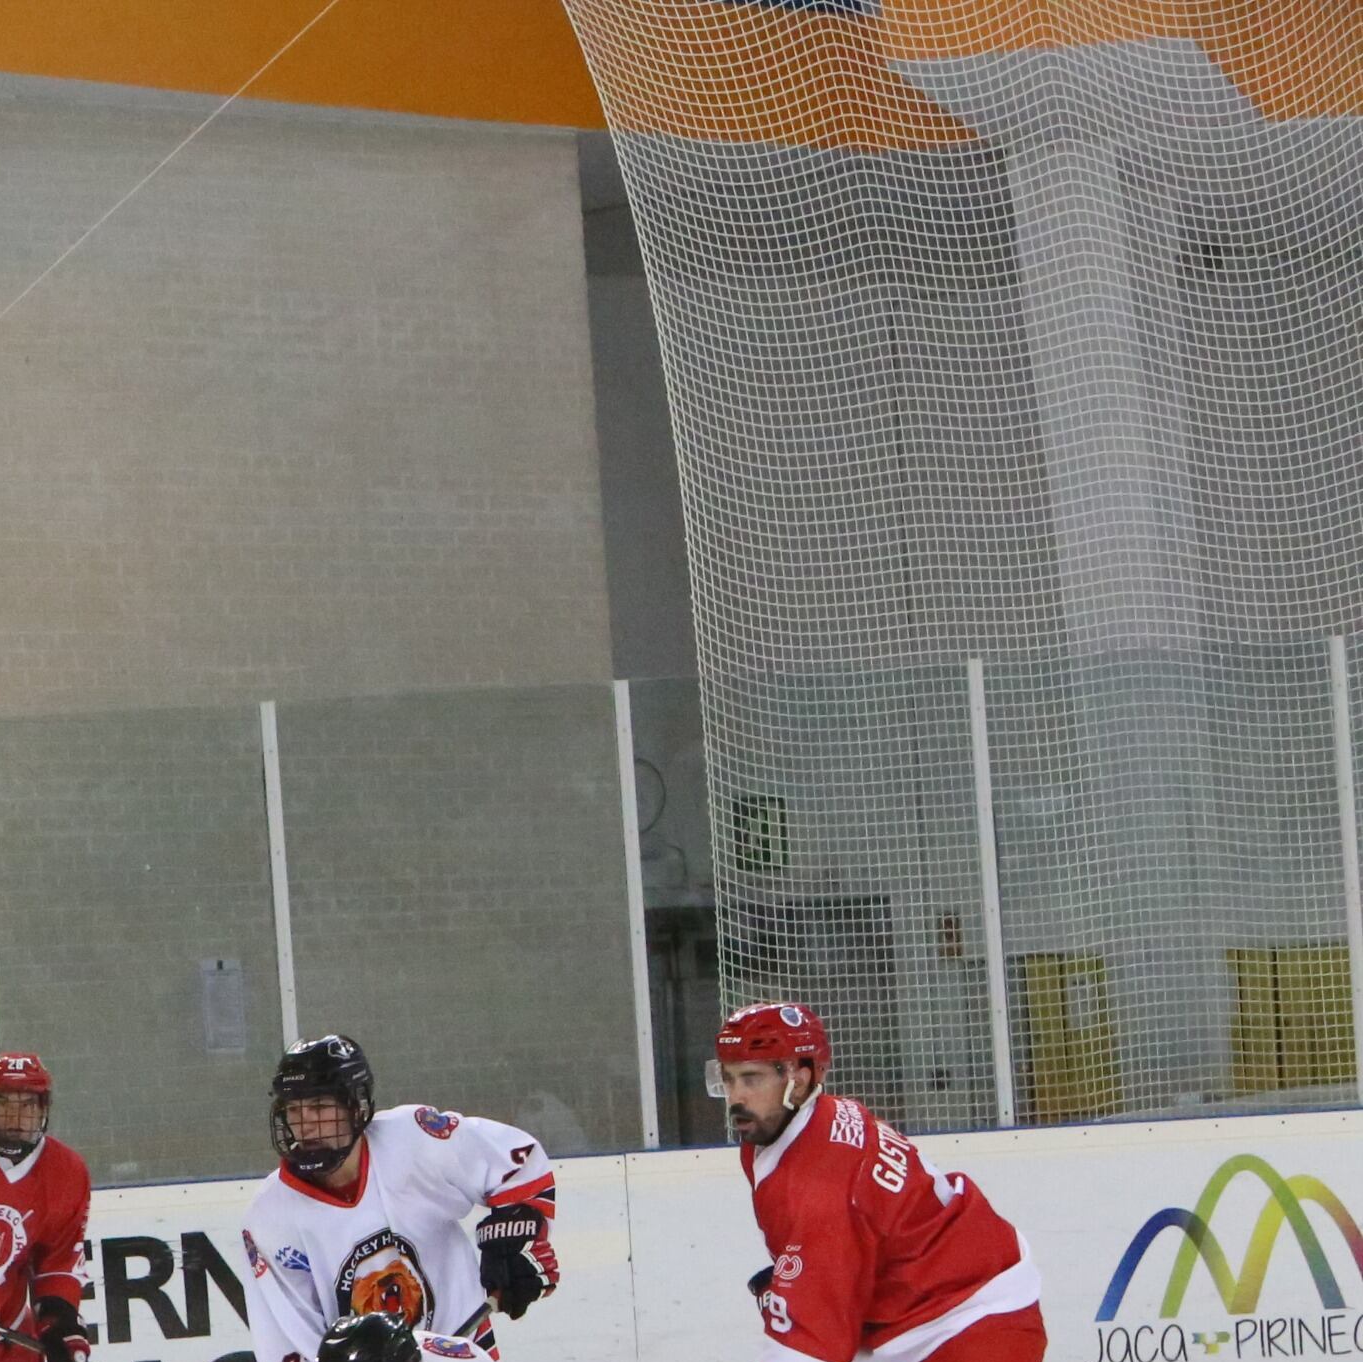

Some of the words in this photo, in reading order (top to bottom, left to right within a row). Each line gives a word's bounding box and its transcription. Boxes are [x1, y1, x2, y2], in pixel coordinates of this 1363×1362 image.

[719, 1036, 741, 1044] CCM
[794, 1044, 815, 1053] CCM
[477, 1218, 537, 1244] ARRIOR
